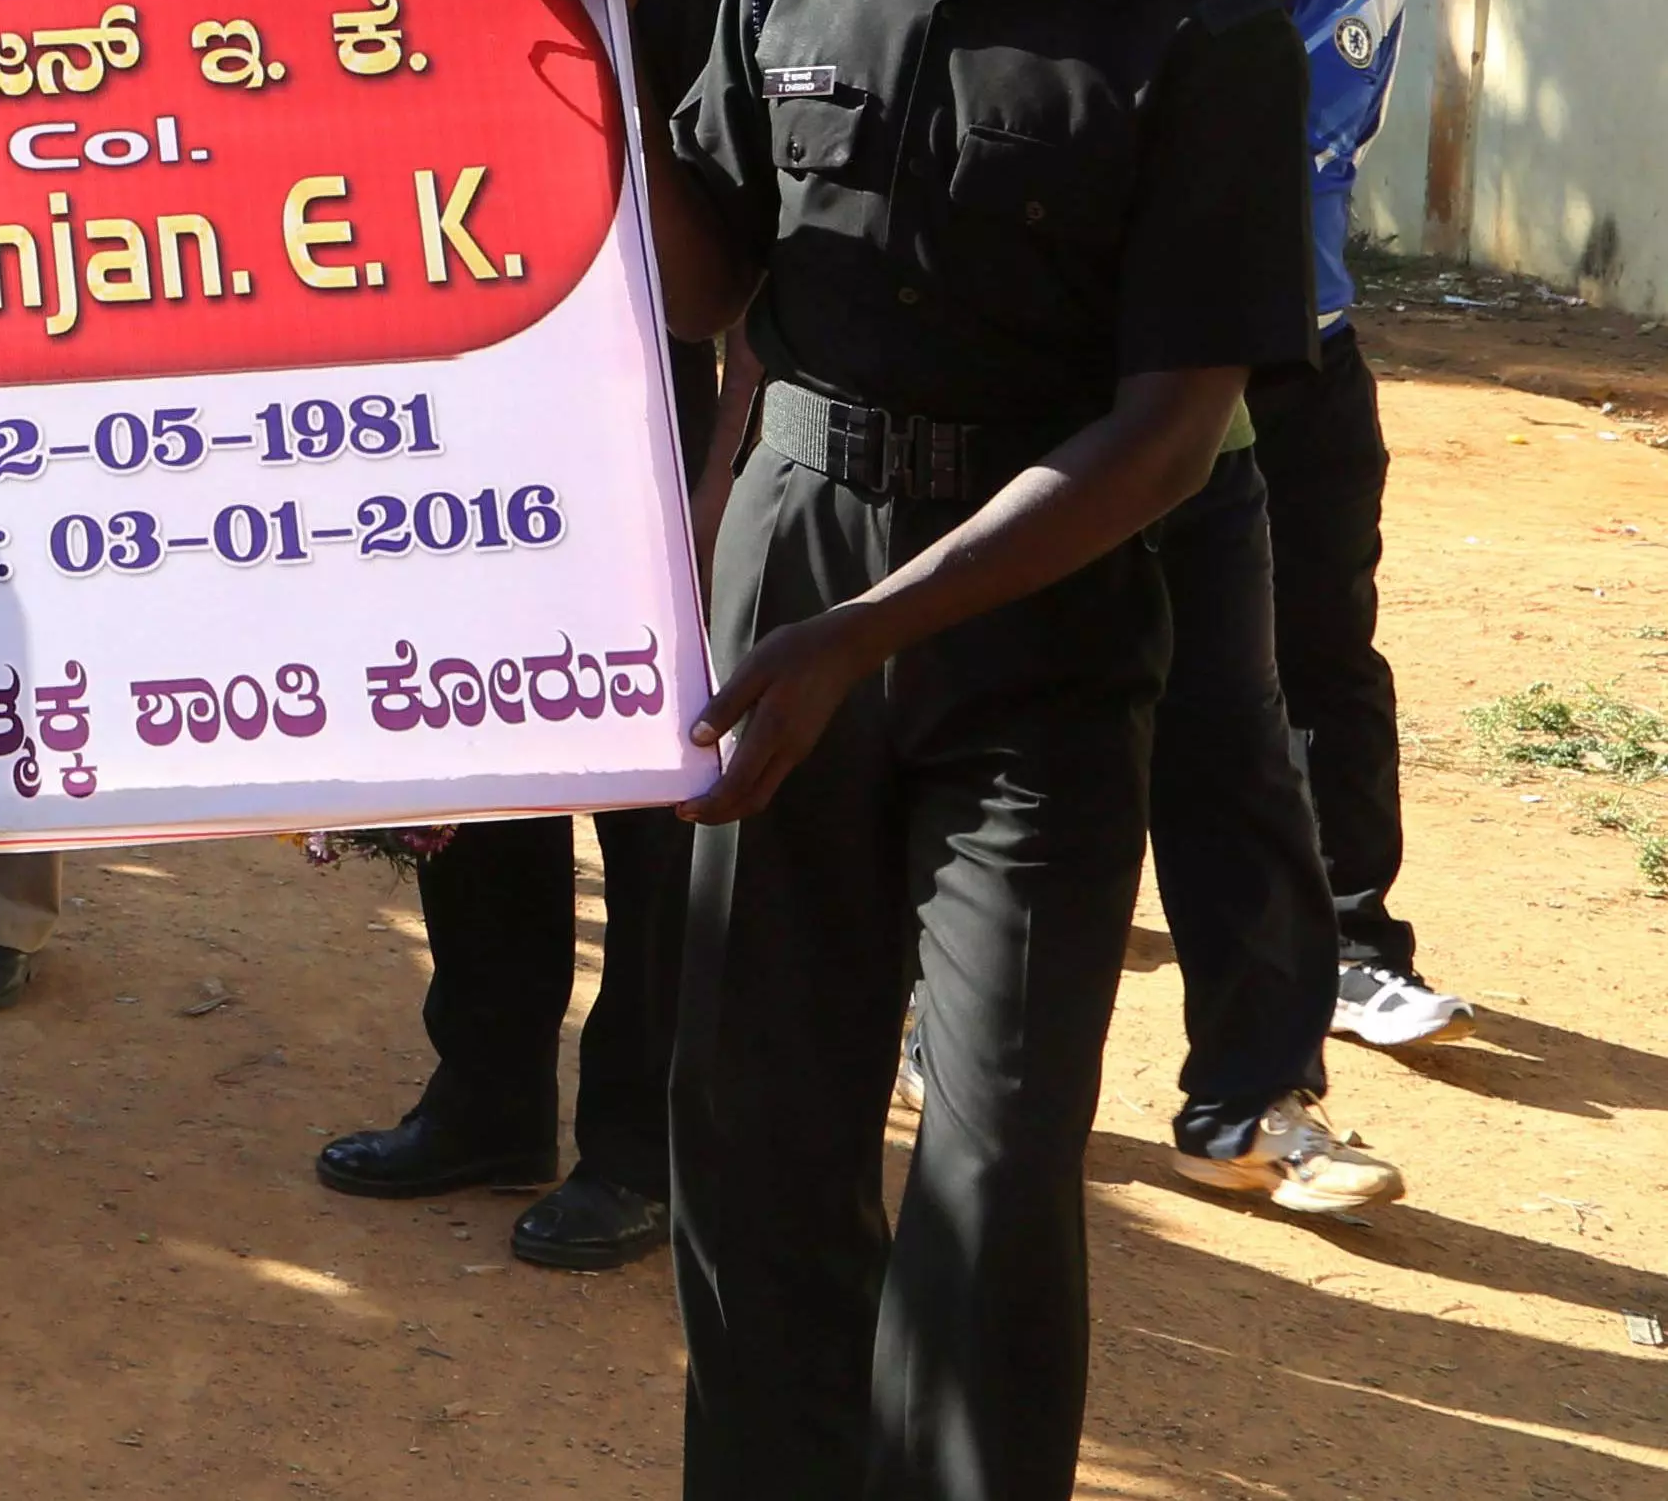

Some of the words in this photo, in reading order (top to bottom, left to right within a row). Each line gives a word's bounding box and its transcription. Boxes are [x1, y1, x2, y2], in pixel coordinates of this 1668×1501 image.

[9, 116, 210, 170] Col.
[282, 175, 384, 289] E.
[414, 166, 525, 284] K.
[49, 484, 564, 574] 03-01-2016
[130, 662, 327, 746] ಶಾಂತಿ
[365, 625, 664, 732] ಕೋರುವ
